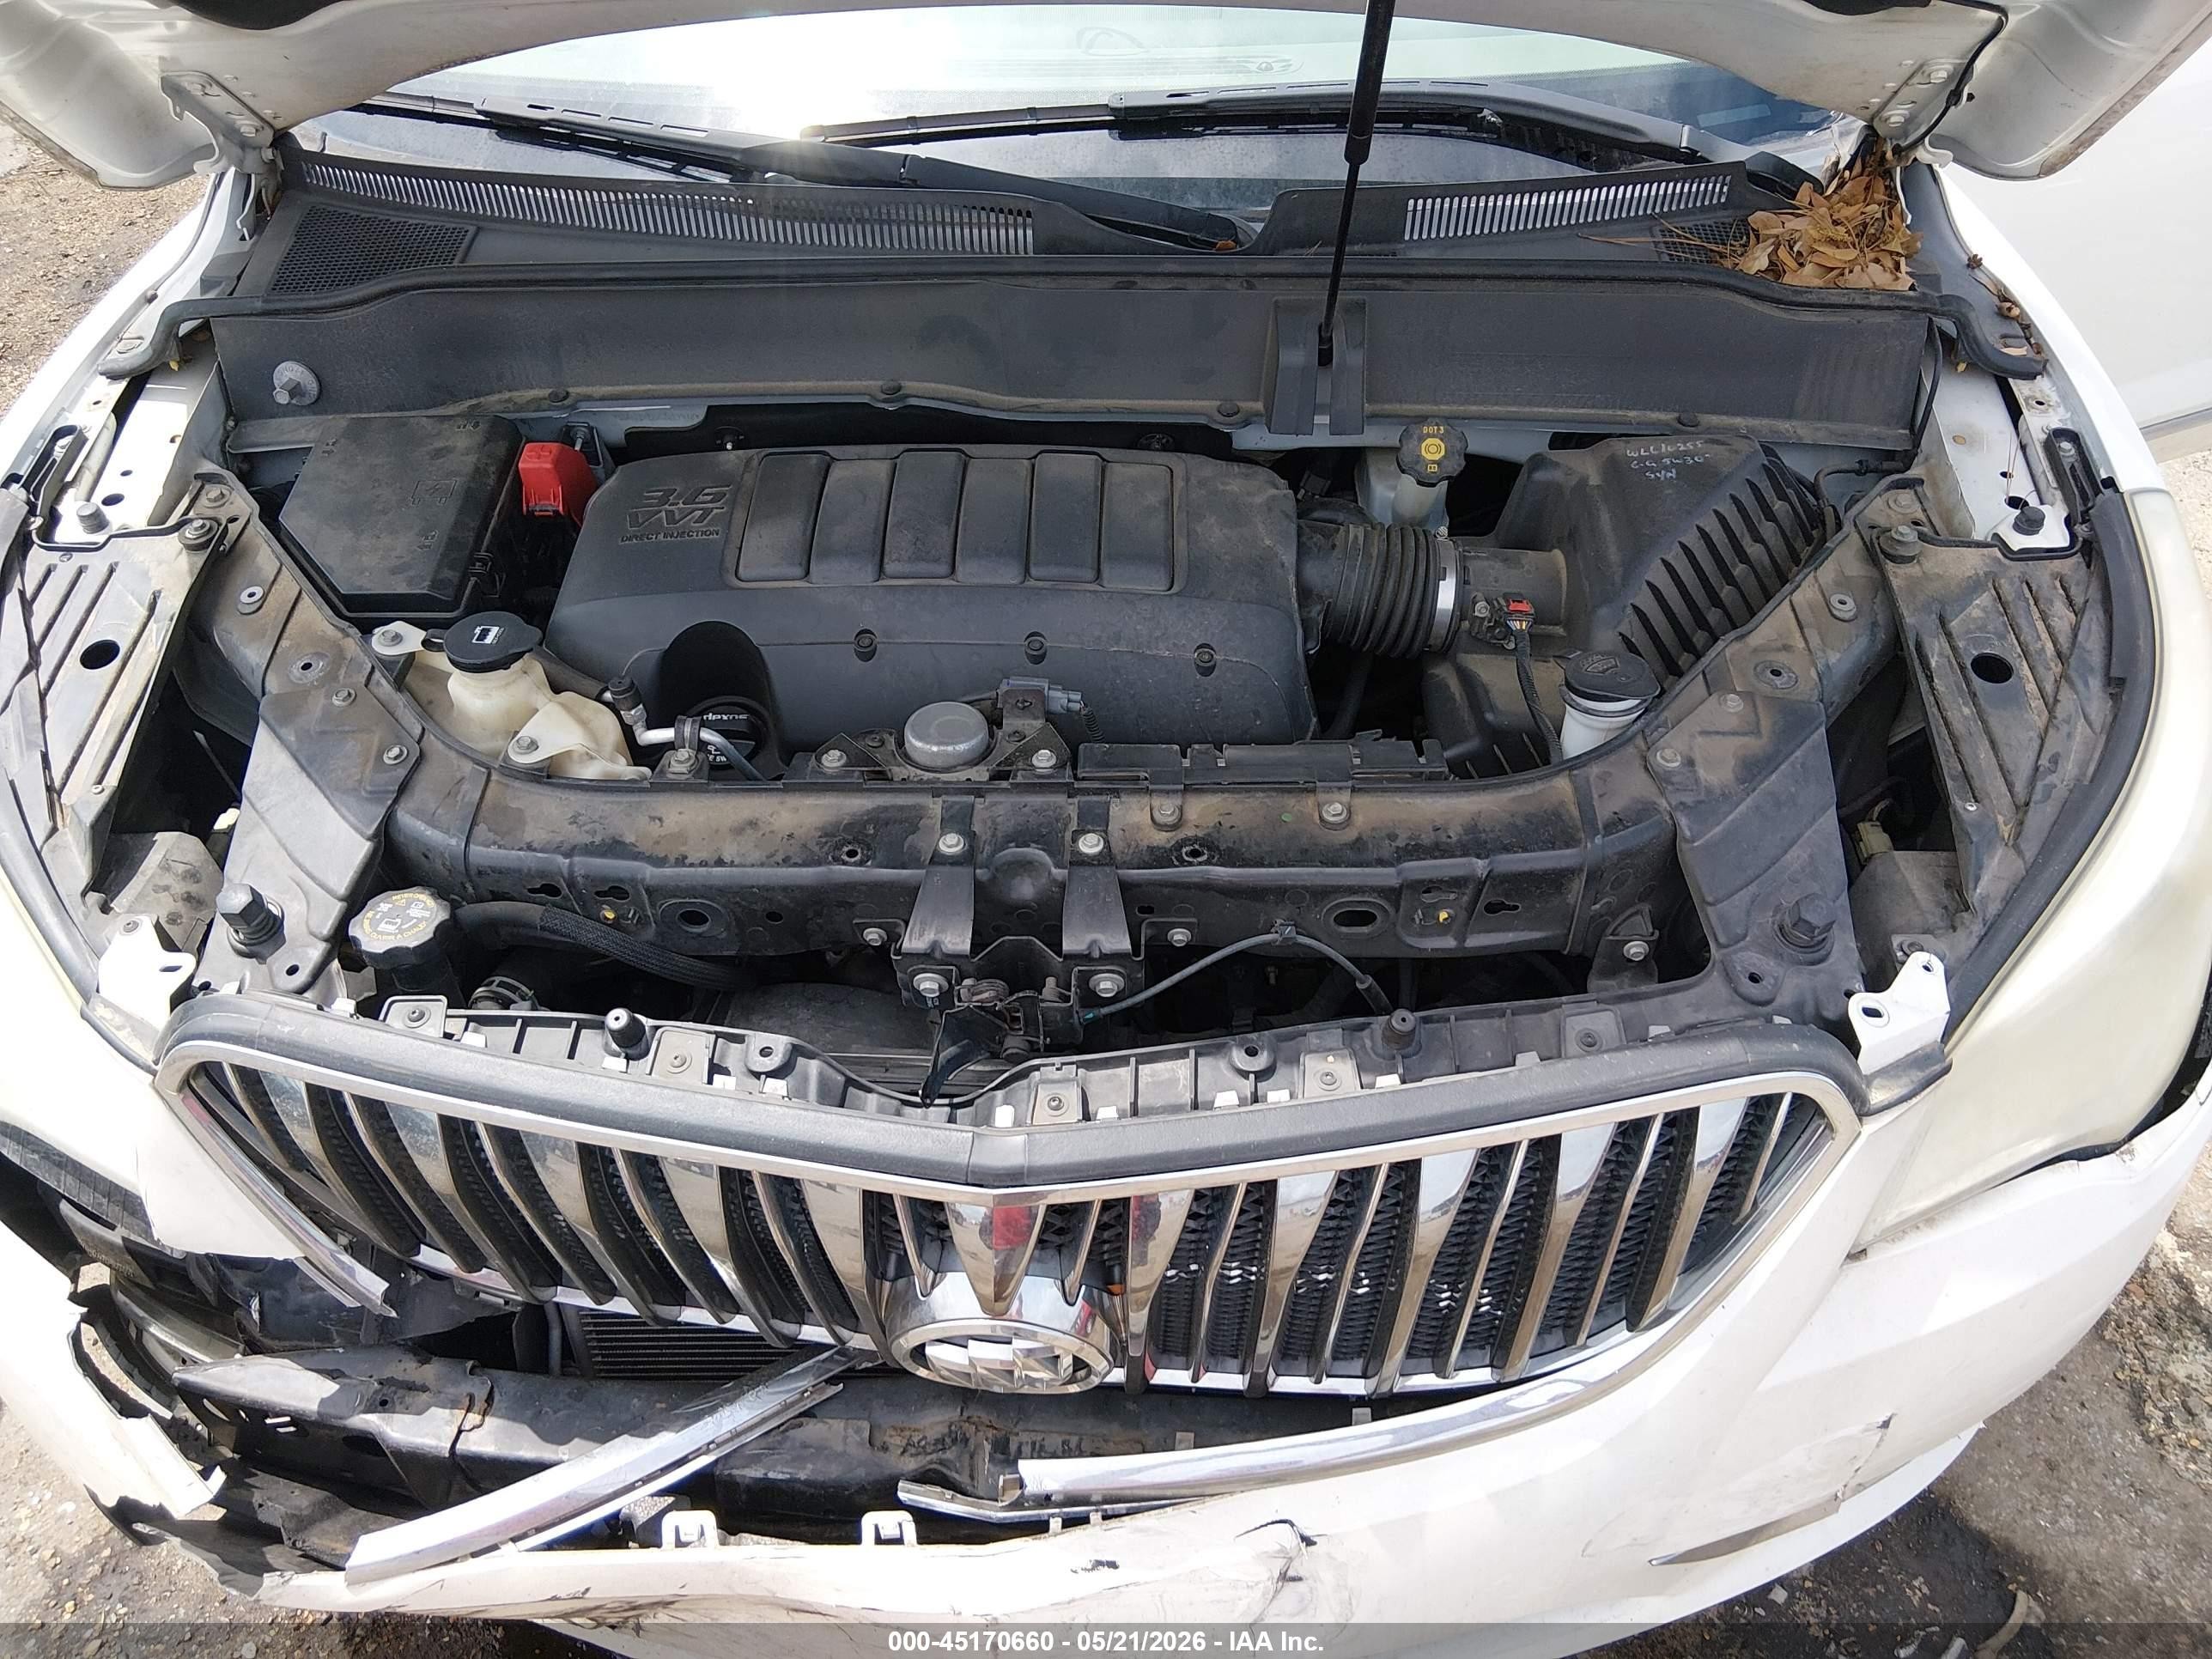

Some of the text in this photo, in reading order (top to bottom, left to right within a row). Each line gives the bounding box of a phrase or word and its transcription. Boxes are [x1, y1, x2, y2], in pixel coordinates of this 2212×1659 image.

[630, 484, 732, 511] 3.6
[627, 507, 726, 530] VVT
[620, 529, 720, 544] DIRECT INJECTION
